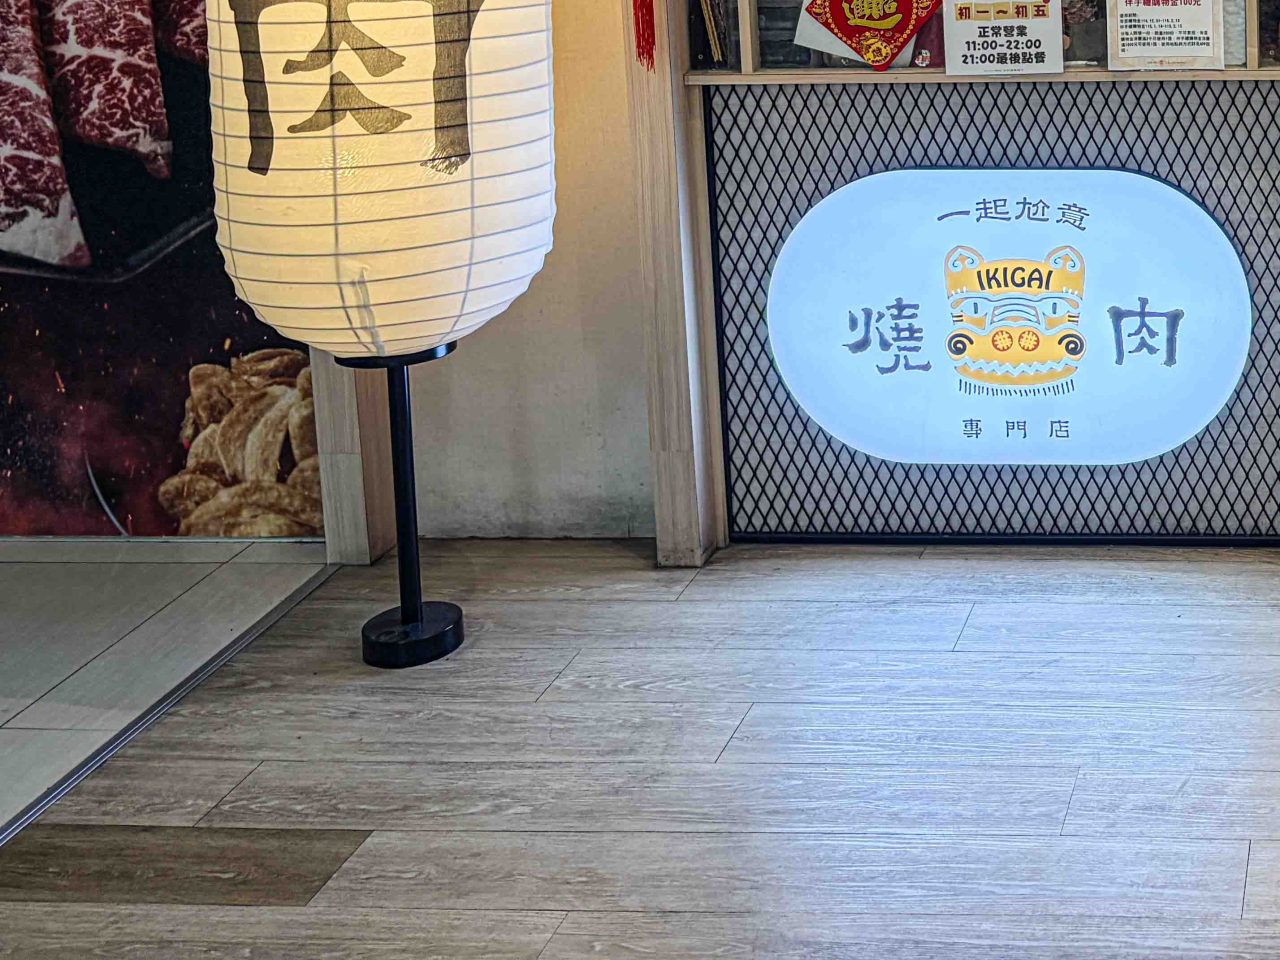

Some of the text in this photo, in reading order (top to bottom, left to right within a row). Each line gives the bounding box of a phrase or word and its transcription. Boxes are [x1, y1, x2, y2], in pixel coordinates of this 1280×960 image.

[977, 26, 1028, 38] 正常營業
[965, 39, 1042, 51] 11:00-22:00
[961, 52, 1046, 65] 21:00最後點餐
[937, 196, 1091, 231] 一起尬意
[976, 266, 1053, 291] IKIGAI
[842, 296, 1185, 376] 燒 肉
[961, 419, 1071, 439] 專門店
